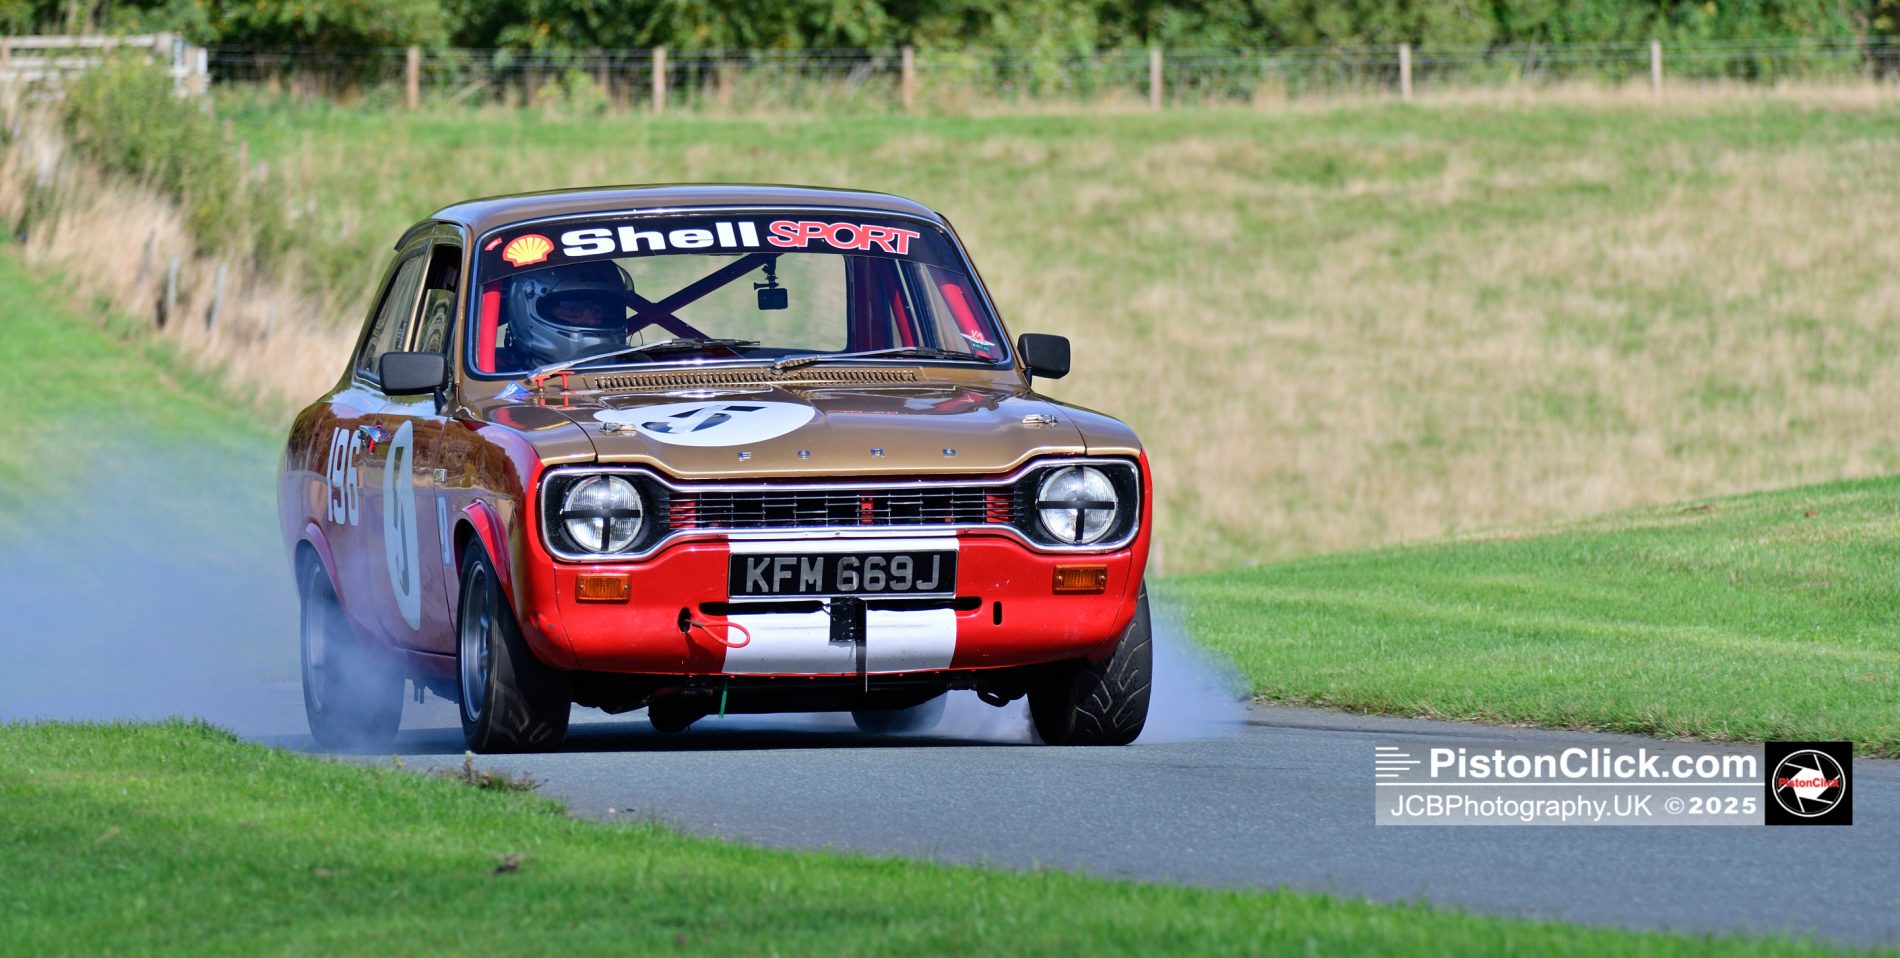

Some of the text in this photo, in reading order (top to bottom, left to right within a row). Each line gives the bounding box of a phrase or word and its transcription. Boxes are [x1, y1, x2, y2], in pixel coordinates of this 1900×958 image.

[561, 220, 920, 257] Shell SPORT
[640, 406, 765, 434] 5
[327, 427, 360, 526] 196
[746, 556, 941, 594] KFM 669J
